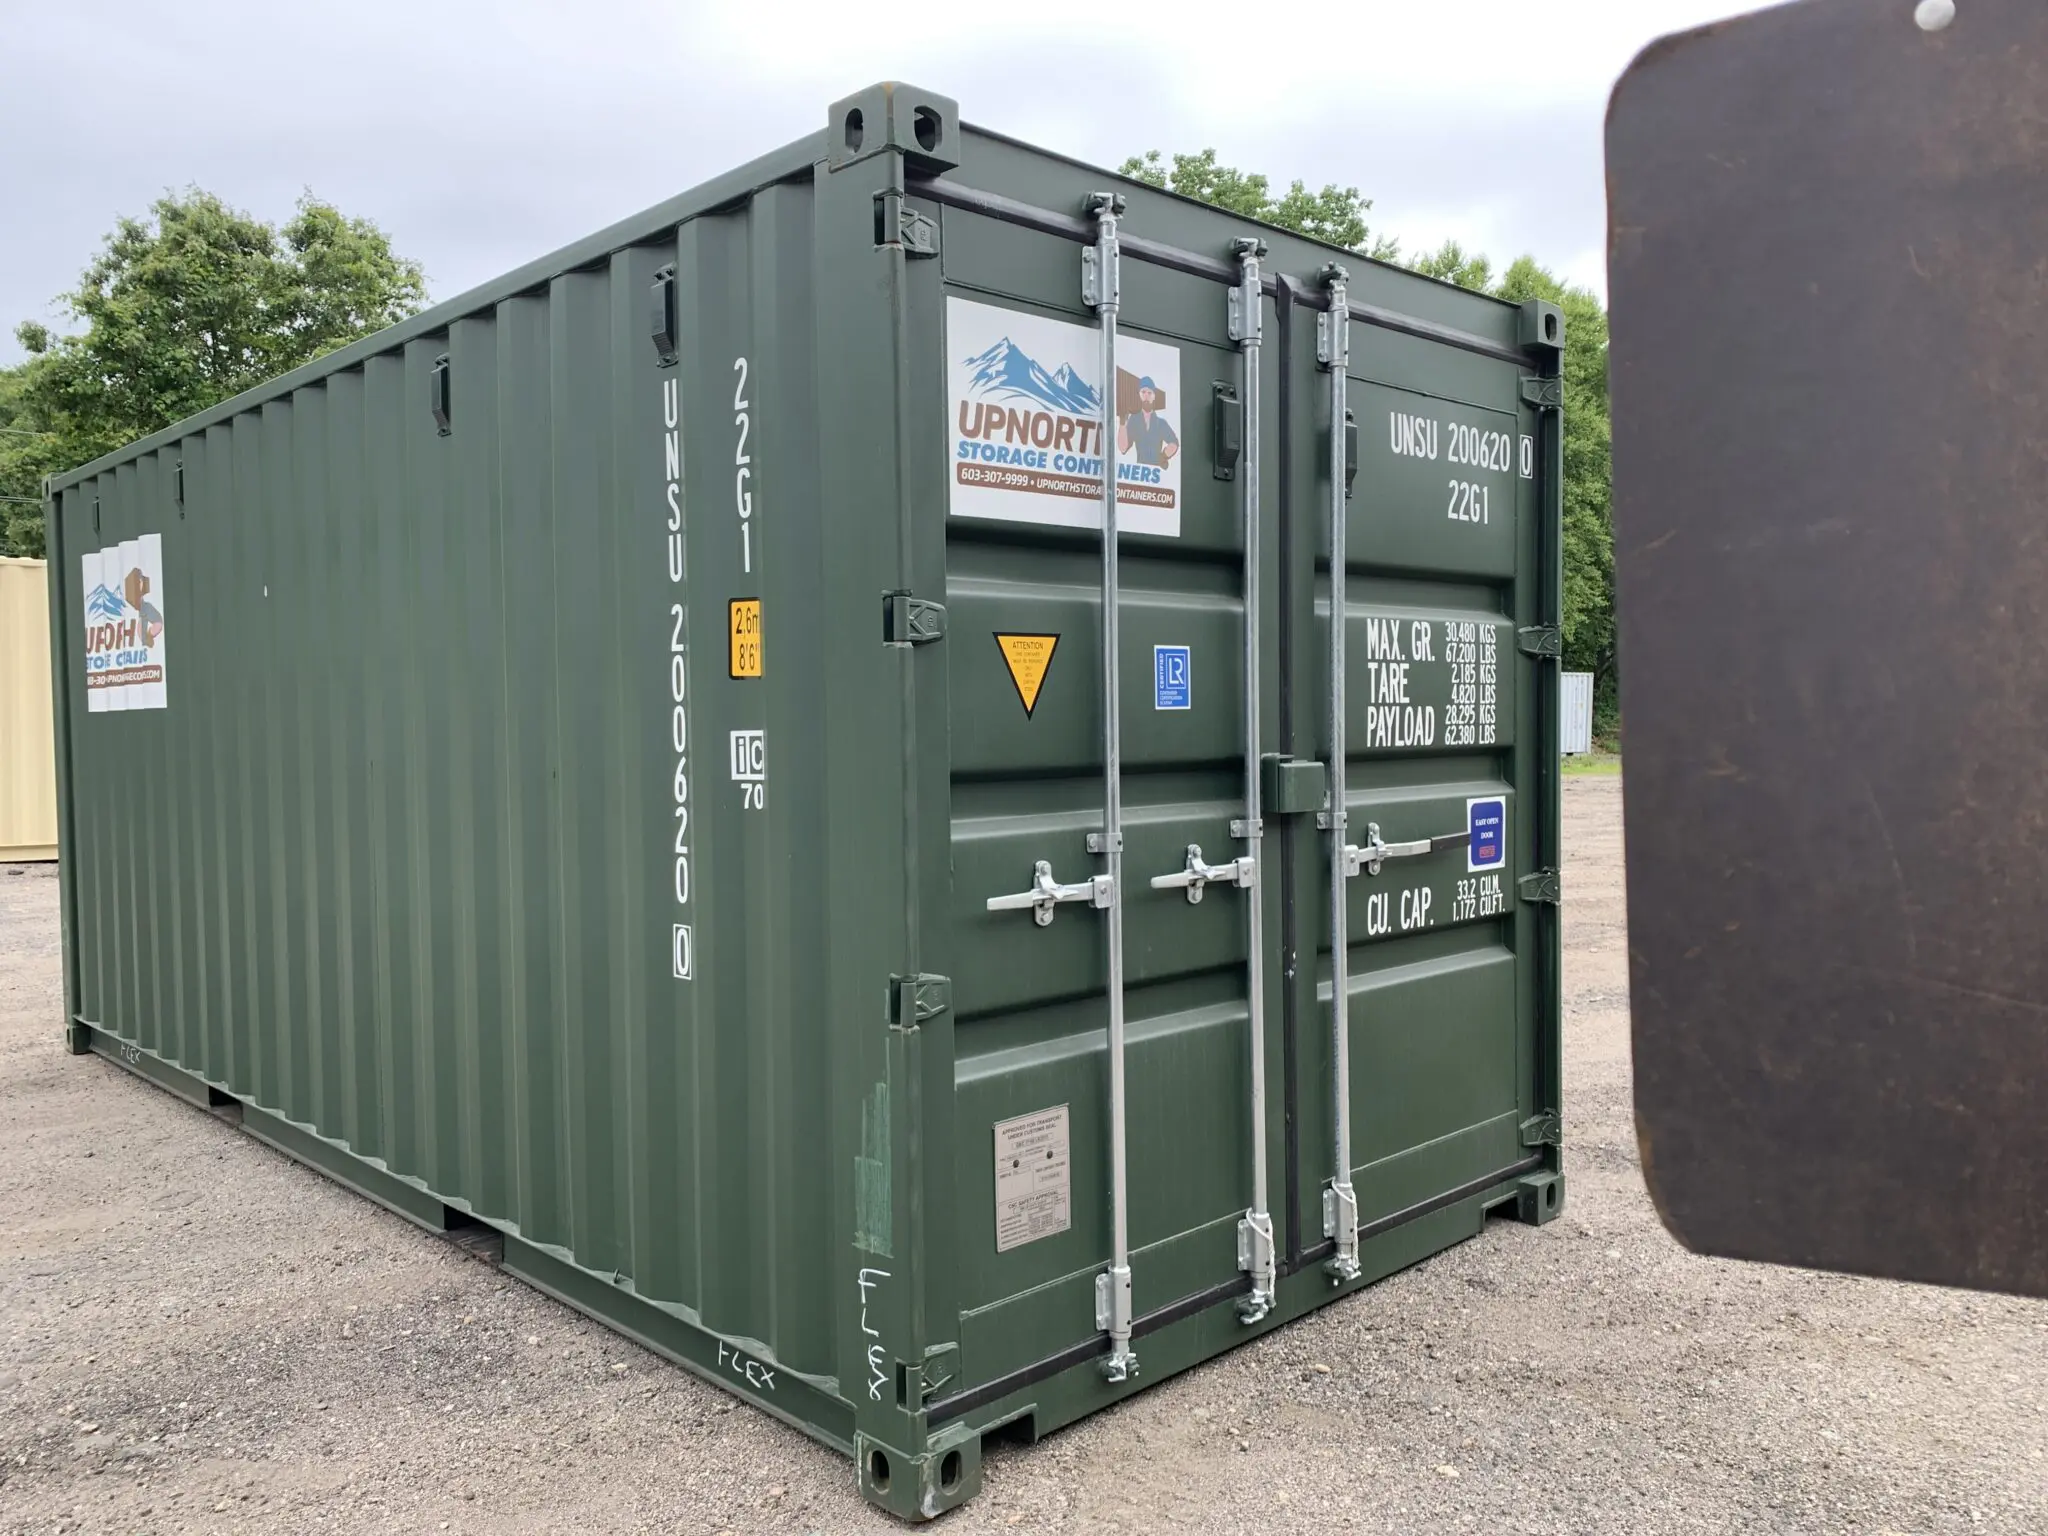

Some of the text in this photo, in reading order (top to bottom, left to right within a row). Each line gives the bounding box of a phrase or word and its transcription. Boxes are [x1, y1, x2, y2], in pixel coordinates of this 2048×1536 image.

[957, 440, 1160, 483] STORAGE CONTNERS
[1390, 411, 1532, 477] UNSU 200620 0
[734, 357, 752, 573] 22G1
[961, 468, 1173, 504] 603-307-9999 UPNORTHSTORAONTAINERS.COM
[1448, 480, 1488, 525] 22G1
[1012, 641, 1044, 650] ATTENTION
[1367, 618, 1405, 660] MAX.
[1412, 621, 1435, 661] GR.
[1479, 623, 1496, 644] KGS
[1480, 644, 1496, 664] LBS
[664, 378, 690, 978] UNSU 200620 0
[1169, 657, 1184, 685] LR
[1368, 662, 1410, 703] TARE
[1480, 664, 1496, 684] KGS
[1479, 684, 1496, 704] LBS
[1367, 706, 1435, 747] PAYLOAD
[1479, 705, 1496, 725] KGS
[1479, 725, 1496, 745] LBS
[740, 783, 764, 810] 70
[1480, 831, 1493, 839] DOOR
[1487, 817, 1499, 825] OPEN
[1367, 892, 1392, 936] CU.
[1400, 886, 1435, 930] CAP.
[1457, 878, 1476, 900] 33.2
